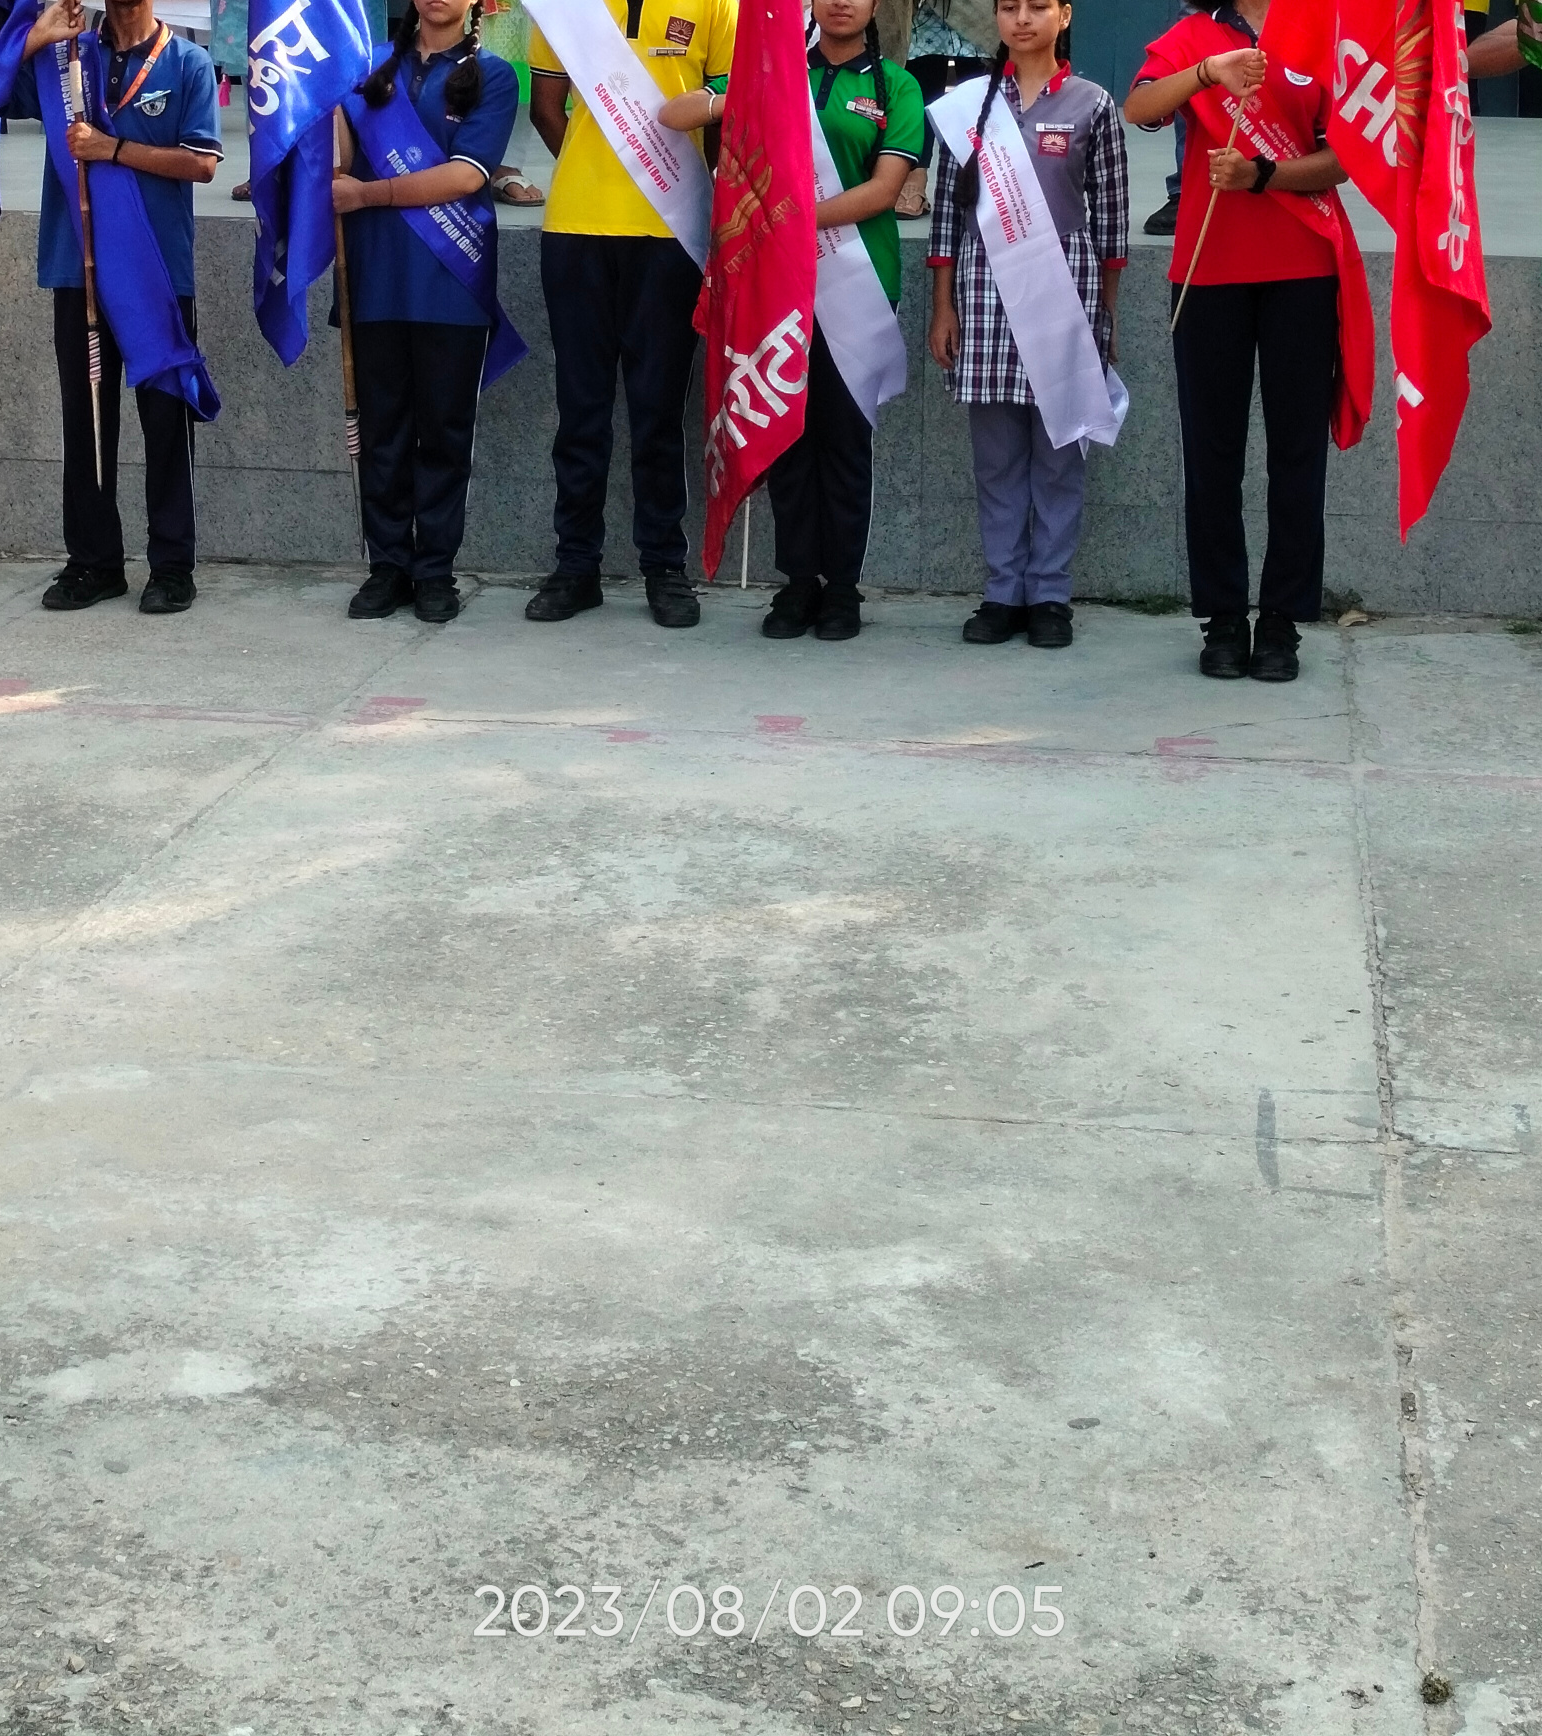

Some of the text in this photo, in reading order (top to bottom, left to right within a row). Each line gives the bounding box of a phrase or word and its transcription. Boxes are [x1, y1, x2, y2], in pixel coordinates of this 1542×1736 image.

[594, 82, 673, 193] SCHOOL VICE-CAPTAIN (Boys)
[622, 96, 680, 183] Kendriya Vidyalaya Nagrota
[428, 205, 482, 263] CAPTAIN (Girls)
[979, 152, 1018, 245] SPORTS CAPTAIN (Girls)
[989, 141, 1027, 239] Kendriya Vidyalaya Nagrota
